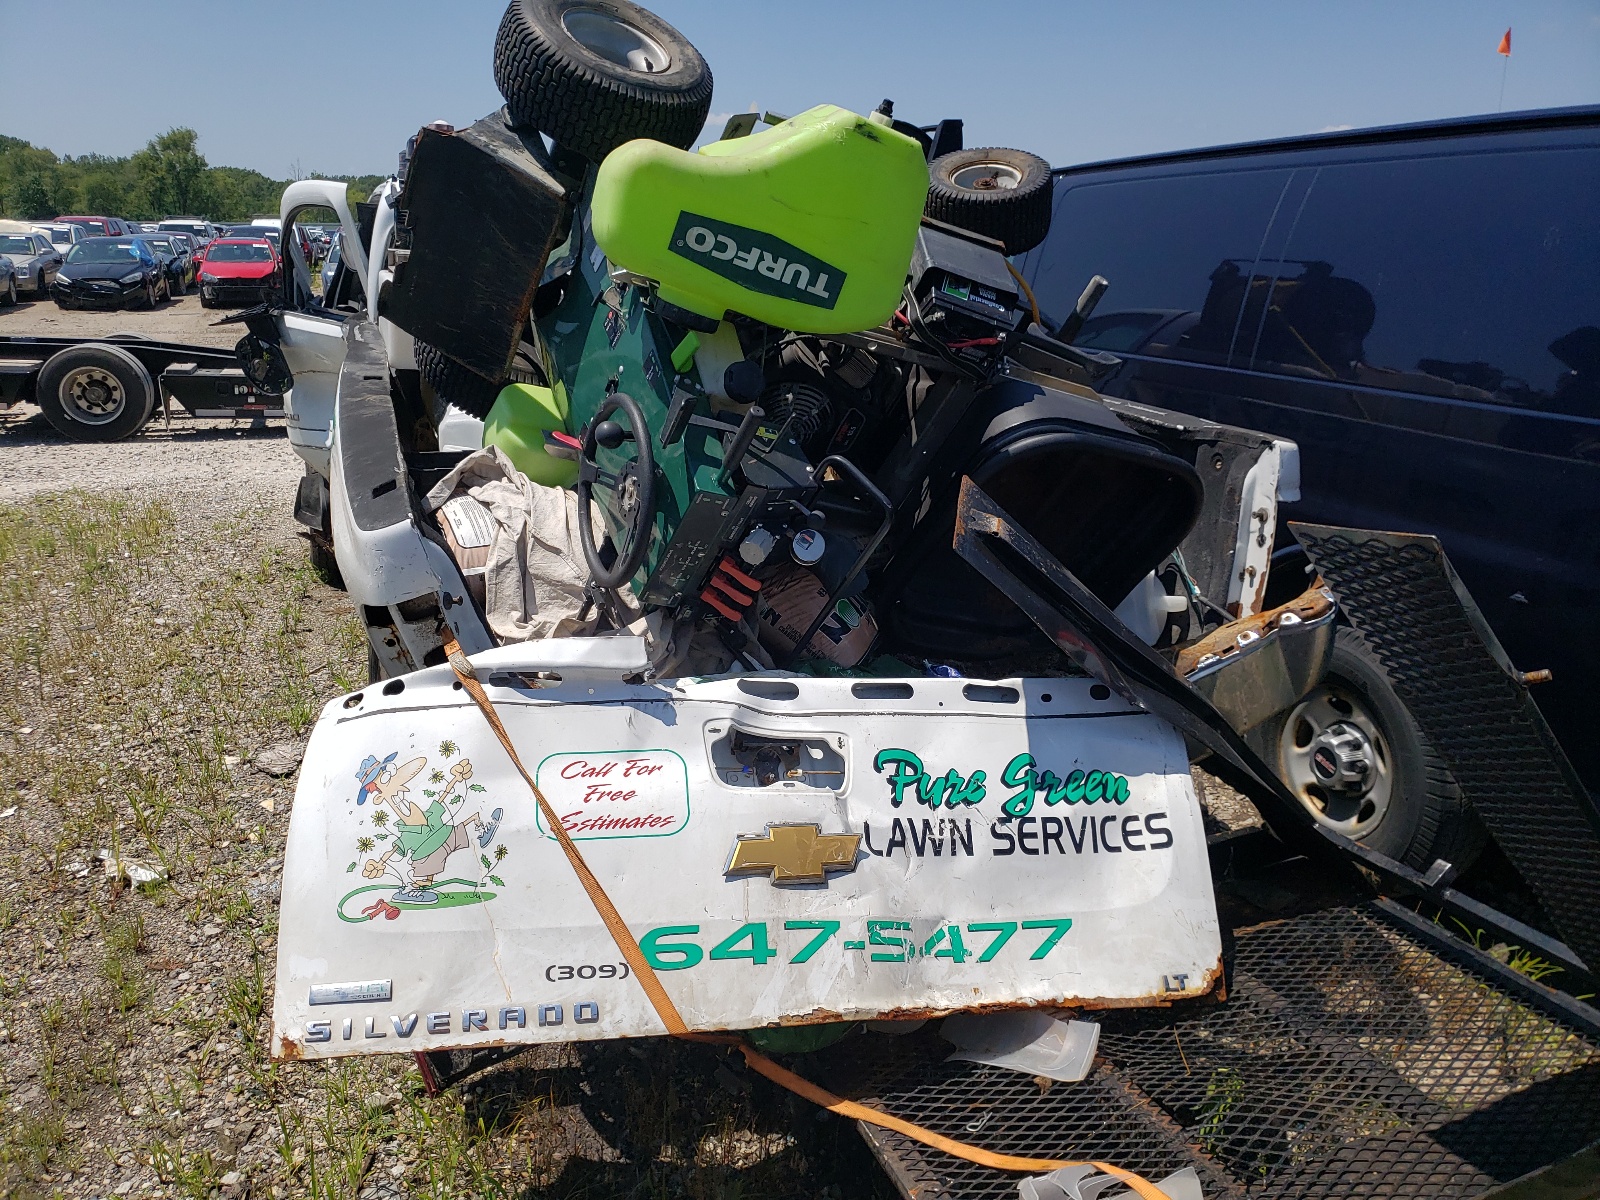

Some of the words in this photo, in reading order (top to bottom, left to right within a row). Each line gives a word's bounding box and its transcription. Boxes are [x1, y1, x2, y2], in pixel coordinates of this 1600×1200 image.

[685, 226, 830, 299] TURFCO
[560, 760, 619, 780] Call
[623, 758, 663, 778] For
[873, 747, 988, 809] Pure
[999, 752, 1131, 818] Green
[583, 783, 638, 804] Free
[551, 810, 676, 833] Estimates
[862, 816, 975, 858] LAWN
[989, 811, 1174, 857] SERVICES
[544, 964, 629, 982] (309)
[637, 917, 1074, 972] 647-5477
[1162, 973, 1189, 992] LT
[304, 1000, 600, 1043] SILVERADO
